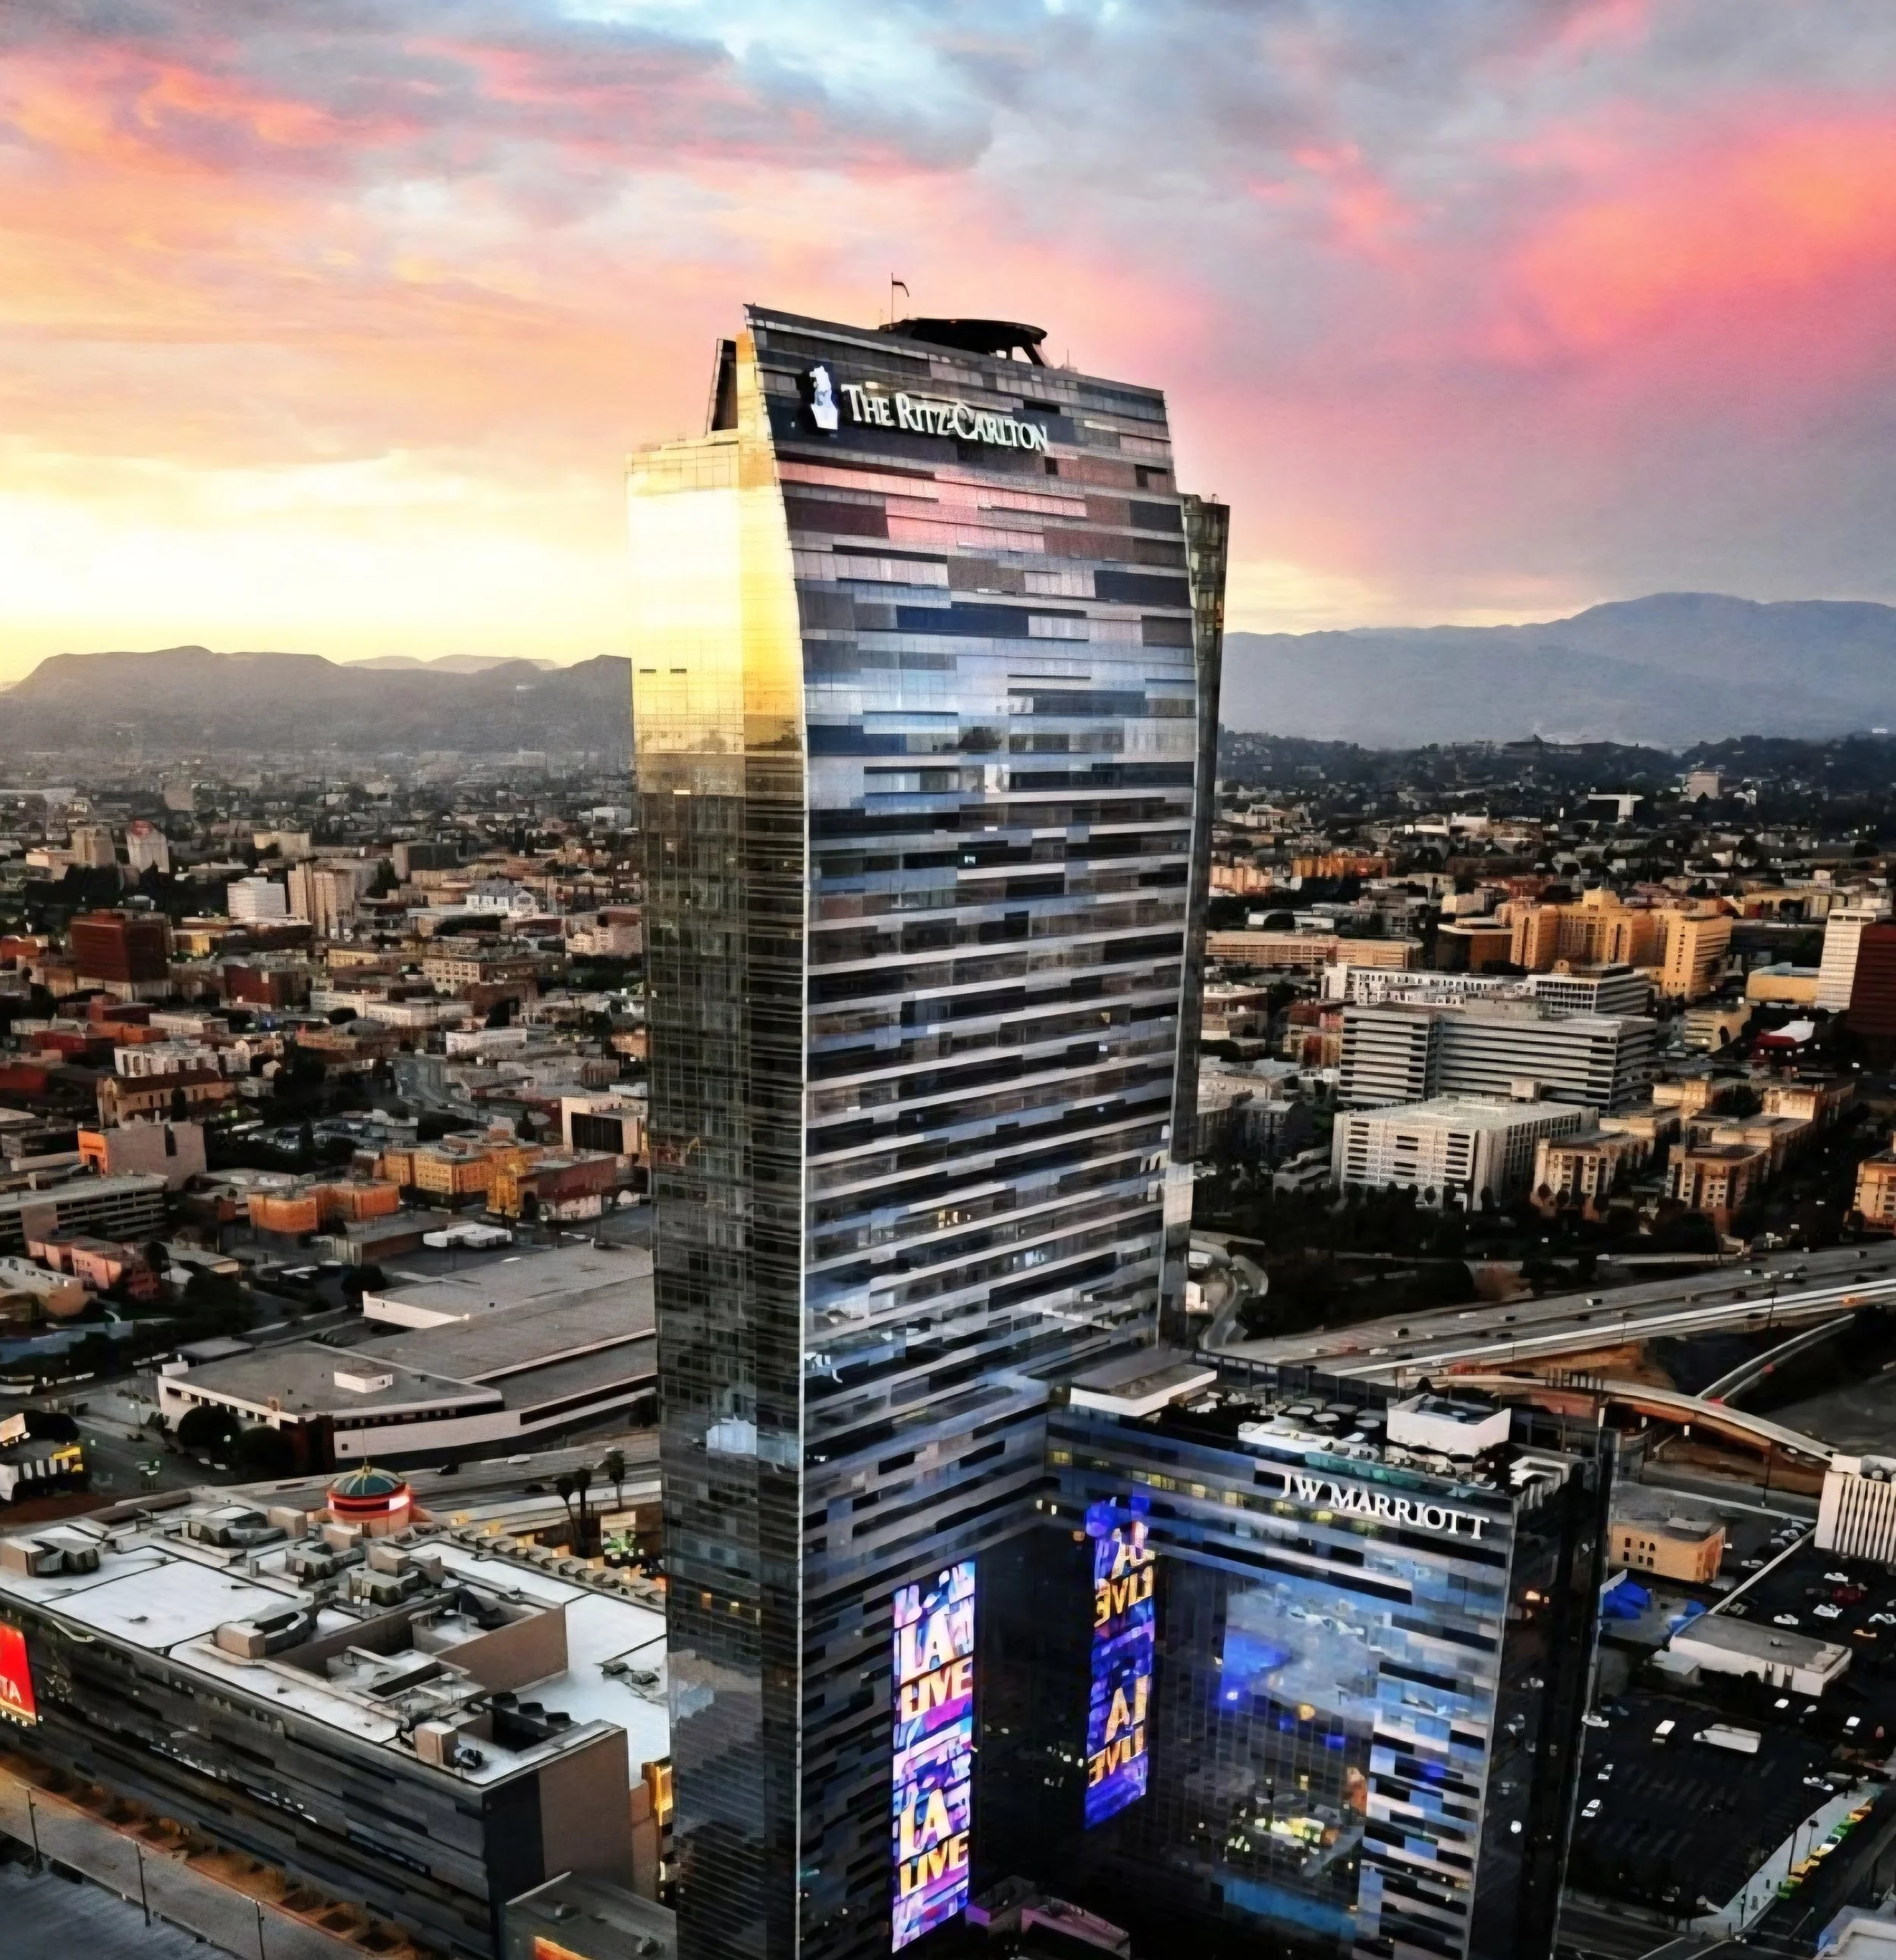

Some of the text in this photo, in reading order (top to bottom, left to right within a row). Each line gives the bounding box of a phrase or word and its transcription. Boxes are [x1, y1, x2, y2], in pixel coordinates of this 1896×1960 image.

[841, 384, 895, 426] THE
[1280, 1472, 1489, 1540] JW MARRIOTT
[900, 1657, 973, 1723] LIVE
[900, 1830, 970, 1899] LIVE
